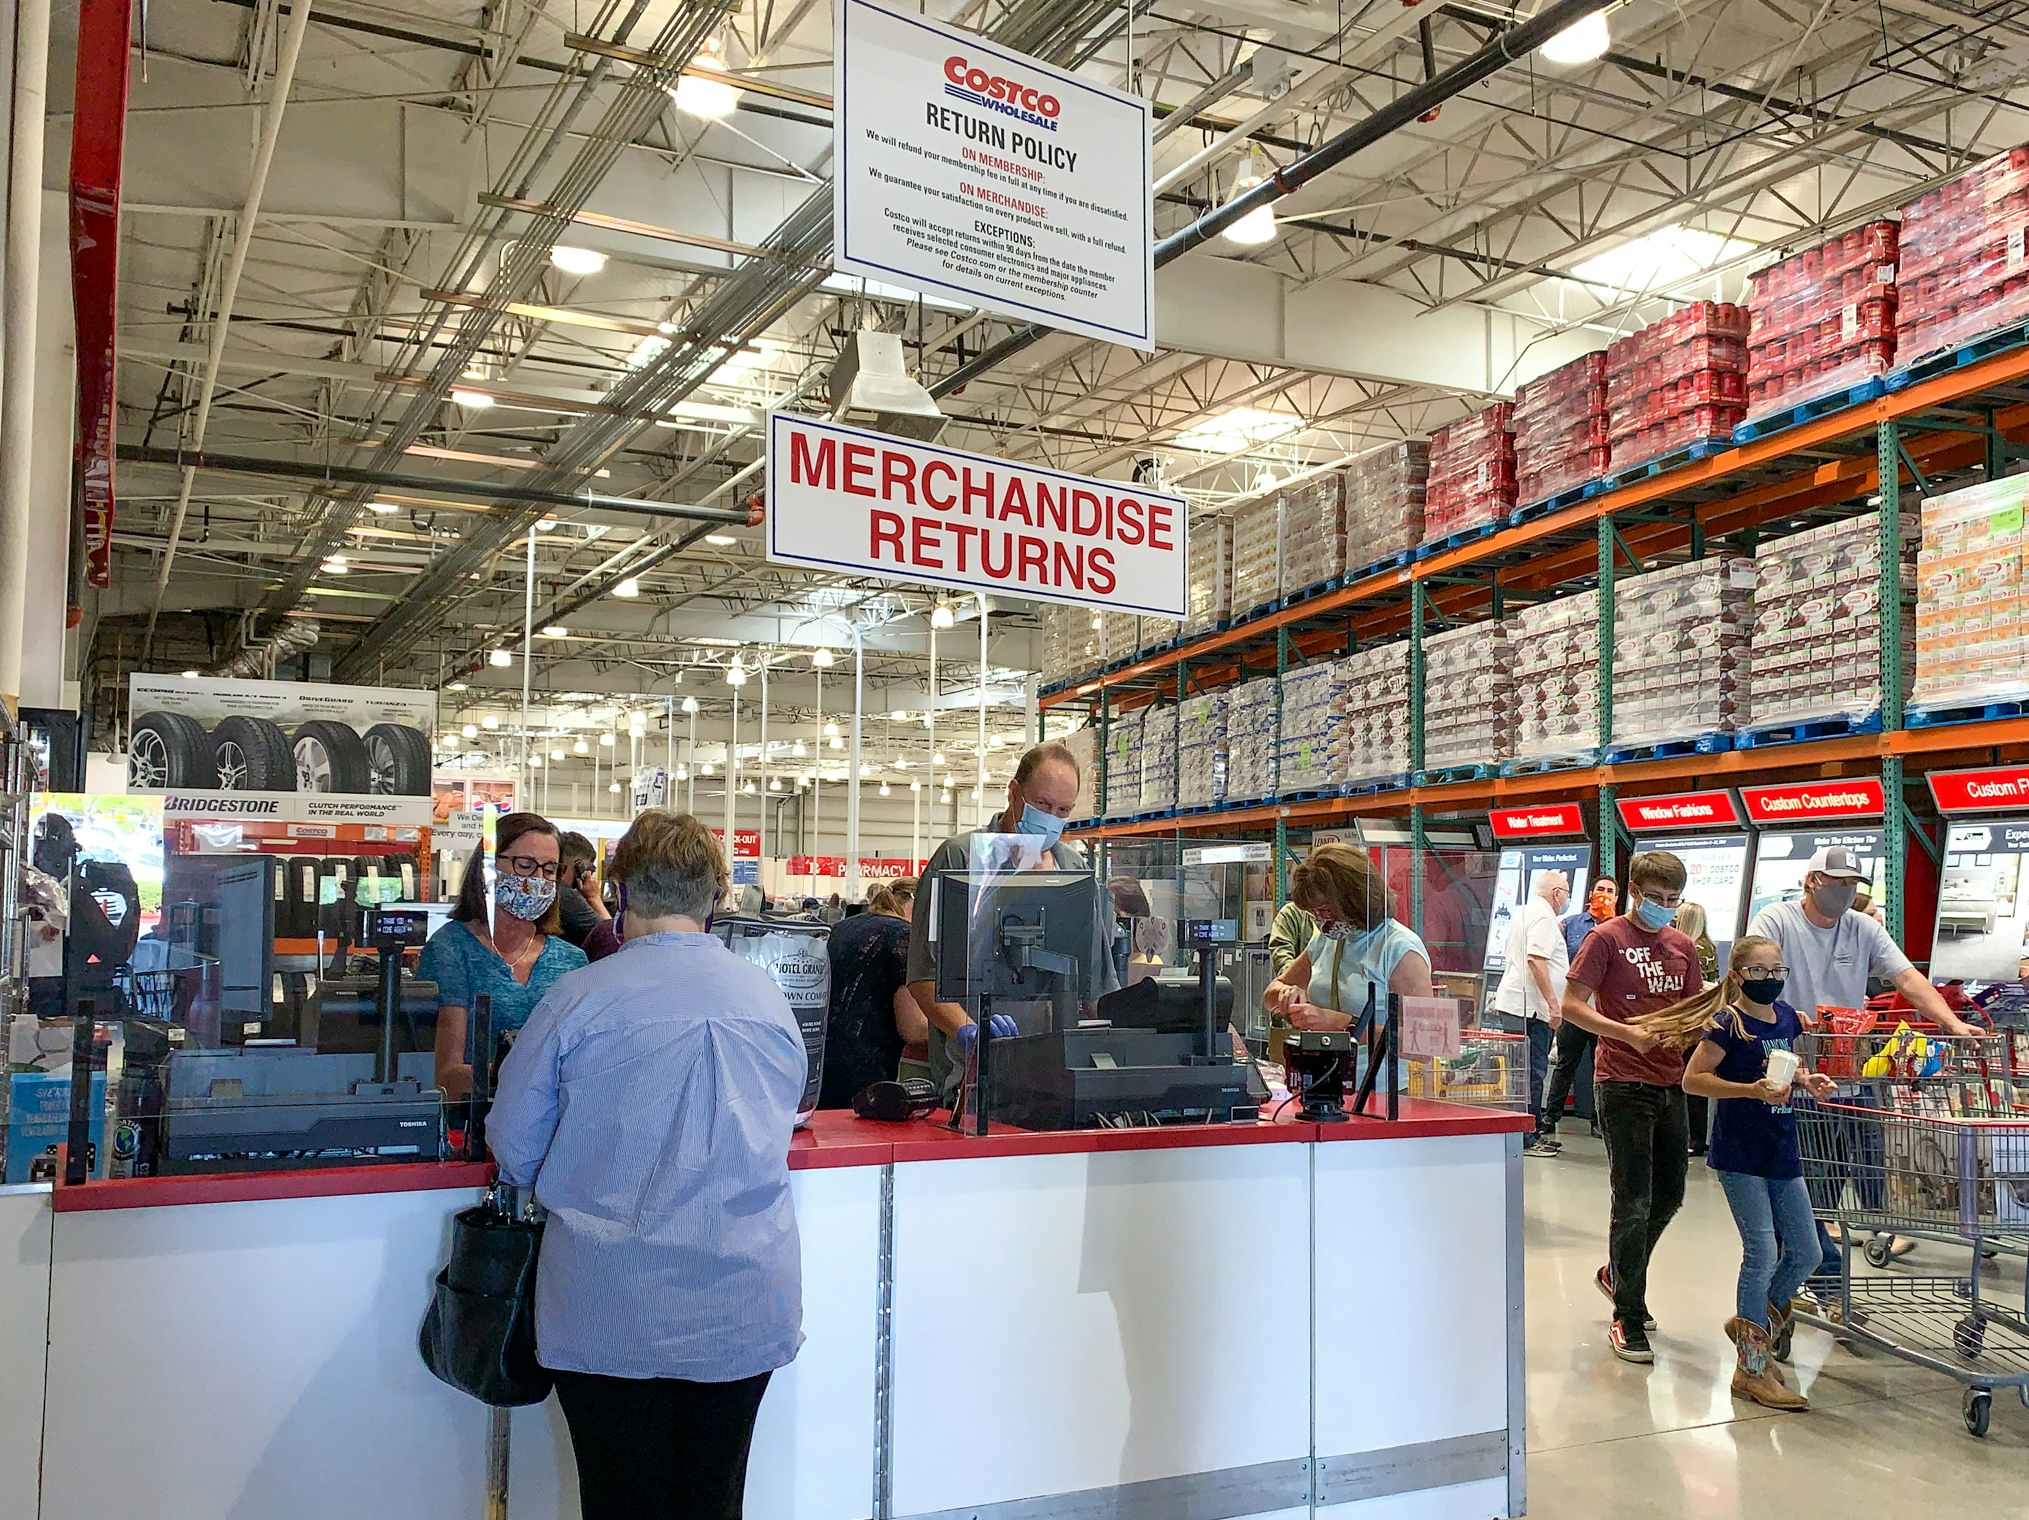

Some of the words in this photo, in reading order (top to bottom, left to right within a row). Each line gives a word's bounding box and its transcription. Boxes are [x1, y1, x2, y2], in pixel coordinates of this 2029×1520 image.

[944, 56, 1061, 118] COSTCO
[980, 96, 1058, 132] WHOLESALE
[926, 102, 1005, 149] RETURN
[1012, 132, 1077, 173] POLICY
[866, 129, 880, 141] We
[881, 135, 896, 147] will
[898, 141, 922, 155] refund
[924, 150, 940, 160] your
[941, 155, 986, 177] membership
[987, 167, 998, 180] fee
[1000, 173, 1006, 182] in
[1008, 175, 1019, 186] full
[1021, 181, 1028, 190] at
[1029, 184, 1041, 195] any
[1042, 187, 1057, 200] time
[1059, 192, 1064, 201] if
[1065, 195, 1077, 206] you
[1078, 200, 1089, 209] are
[962, 147, 976, 161] ON
[979, 153, 1045, 184] MEMBERSHIP:
[869, 167, 882, 179] We
[884, 173, 922, 192] guarantee
[923, 186, 940, 196] your
[941, 191, 983, 210] satisfaction
[985, 204, 994, 214] on
[995, 208, 1015, 222] every
[1015, 215, 1042, 229] product
[1043, 223, 1054, 232] we
[1071, 230, 1086, 242] with
[1092, 237, 1103, 247] full
[960, 182, 974, 196] ON
[977, 187, 1048, 219] MERCHANDISE:
[884, 207, 910, 224] Costco
[912, 218, 927, 228] will
[928, 223, 954, 237] accept
[955, 230, 980, 244] returns
[982, 238, 1005, 251] within
[1015, 246, 1031, 260] days
[1032, 251, 1048, 264] from
[1049, 256, 1060, 267] the
[1061, 260, 1076, 272] date
[1077, 264, 1088, 275] the
[1089, 268, 1115, 283] member
[974, 220, 1036, 248] EXCEPTIONS:
[893, 224, 925, 239] receives
[926, 232, 958, 249] selected
[960, 242, 995, 259] consumer
[996, 253, 1035, 271] electronics
[1036, 264, 1049, 275] and
[1050, 271, 1069, 282] major
[906, 237, 933, 253] Please
[934, 248, 949, 257] see
[998, 265, 1007, 273] or
[1008, 267, 1020, 278] the
[1022, 272, 1069, 292] membership
[1070, 285, 1098, 299] counter
[943, 260, 954, 269] for
[955, 263, 982, 277] details
[983, 273, 994, 281] on
[995, 275, 1023, 289] current
[790, 431, 1174, 552] MERCHANDISE
[870, 508, 1116, 596] RETURNS
[164, 795, 280, 814] BRIDGESTONE
[1760, 796, 1801, 812] Custom
[1801, 791, 1870, 809] Countertops
[1967, 781, 2017, 798] Custom
[1527, 813, 1564, 827] Treatment
[1639, 806, 1673, 821] Window
[1673, 803, 1713, 818] Fashions
[1636, 960, 1665, 978] THE
